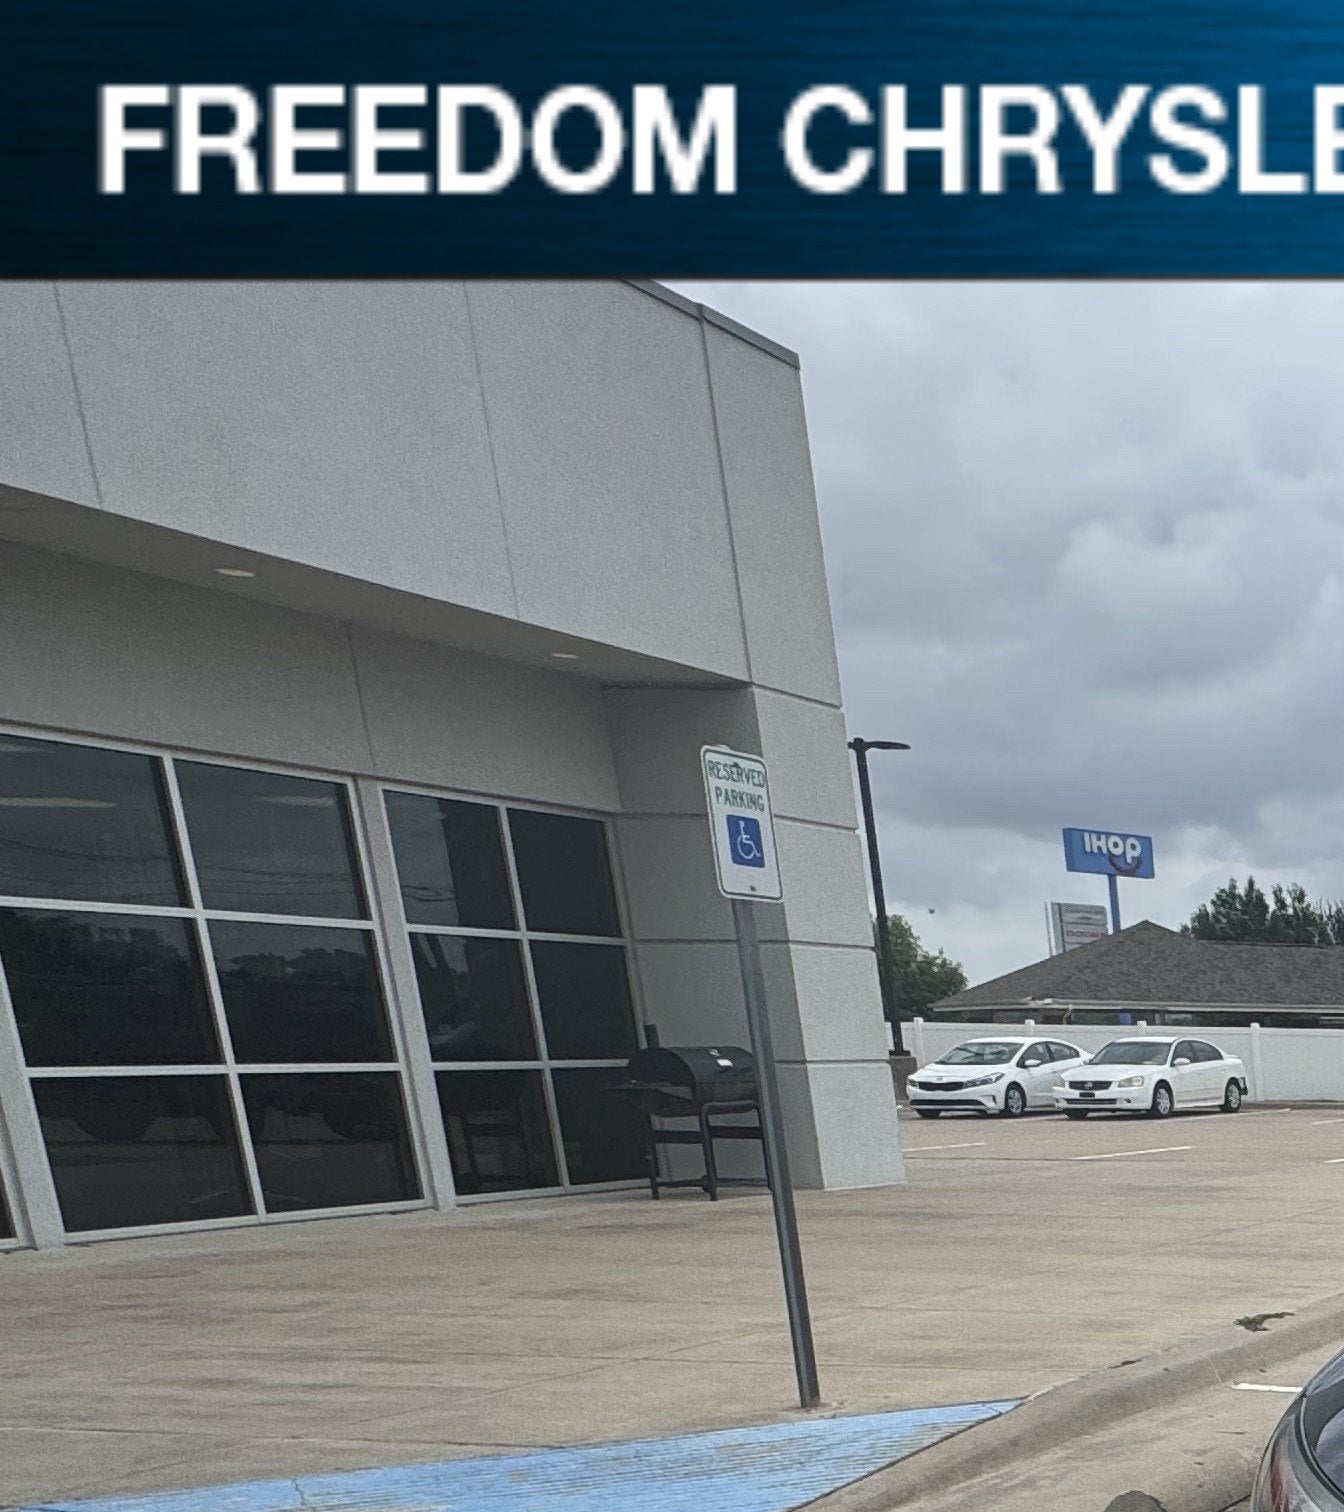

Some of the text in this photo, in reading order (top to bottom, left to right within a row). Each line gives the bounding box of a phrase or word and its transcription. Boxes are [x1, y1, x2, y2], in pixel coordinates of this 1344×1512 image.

[707, 760, 765, 788] RESERVED
[714, 786, 765, 812] PARKING
[1083, 832, 1142, 864] IHOP
